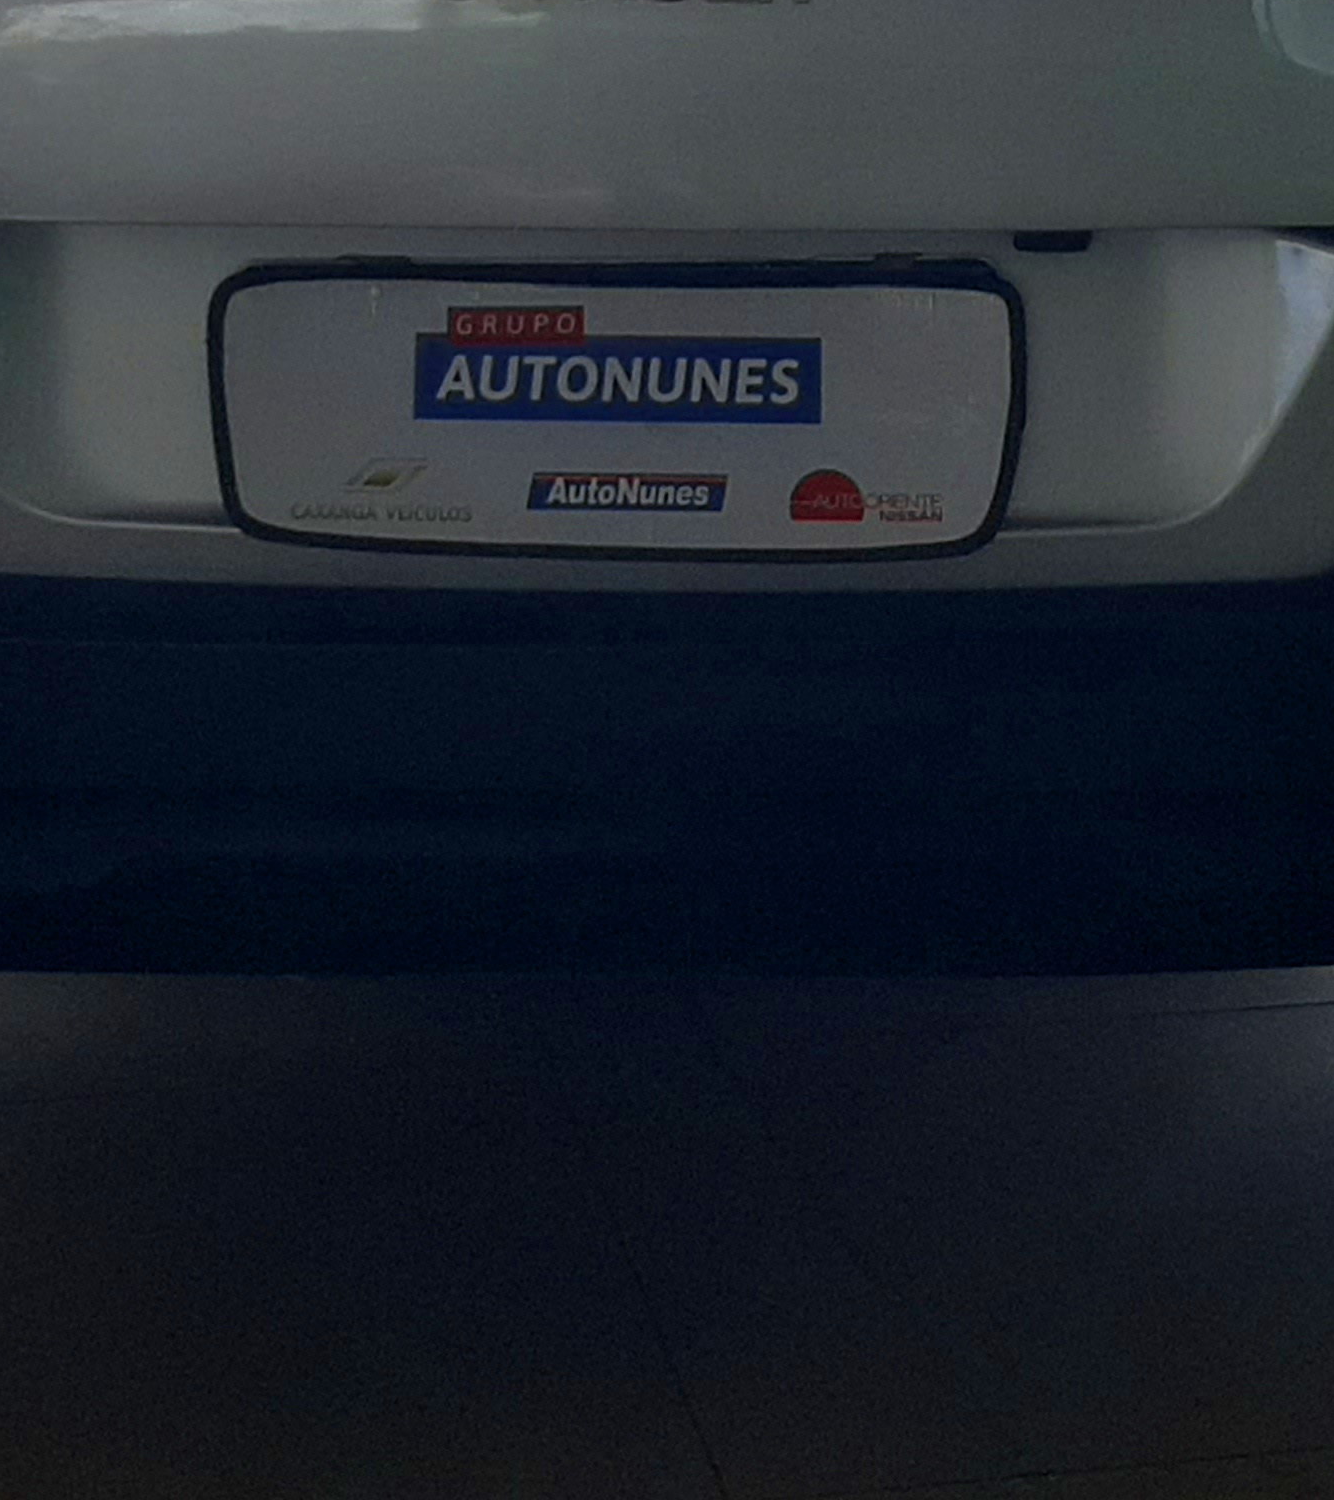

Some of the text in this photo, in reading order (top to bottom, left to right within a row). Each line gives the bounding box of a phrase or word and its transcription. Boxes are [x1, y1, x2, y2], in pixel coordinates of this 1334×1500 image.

[455, 312, 577, 336] GRUPO
[436, 353, 801, 405] AUTONUNES
[547, 476, 710, 507] AutoNunes
